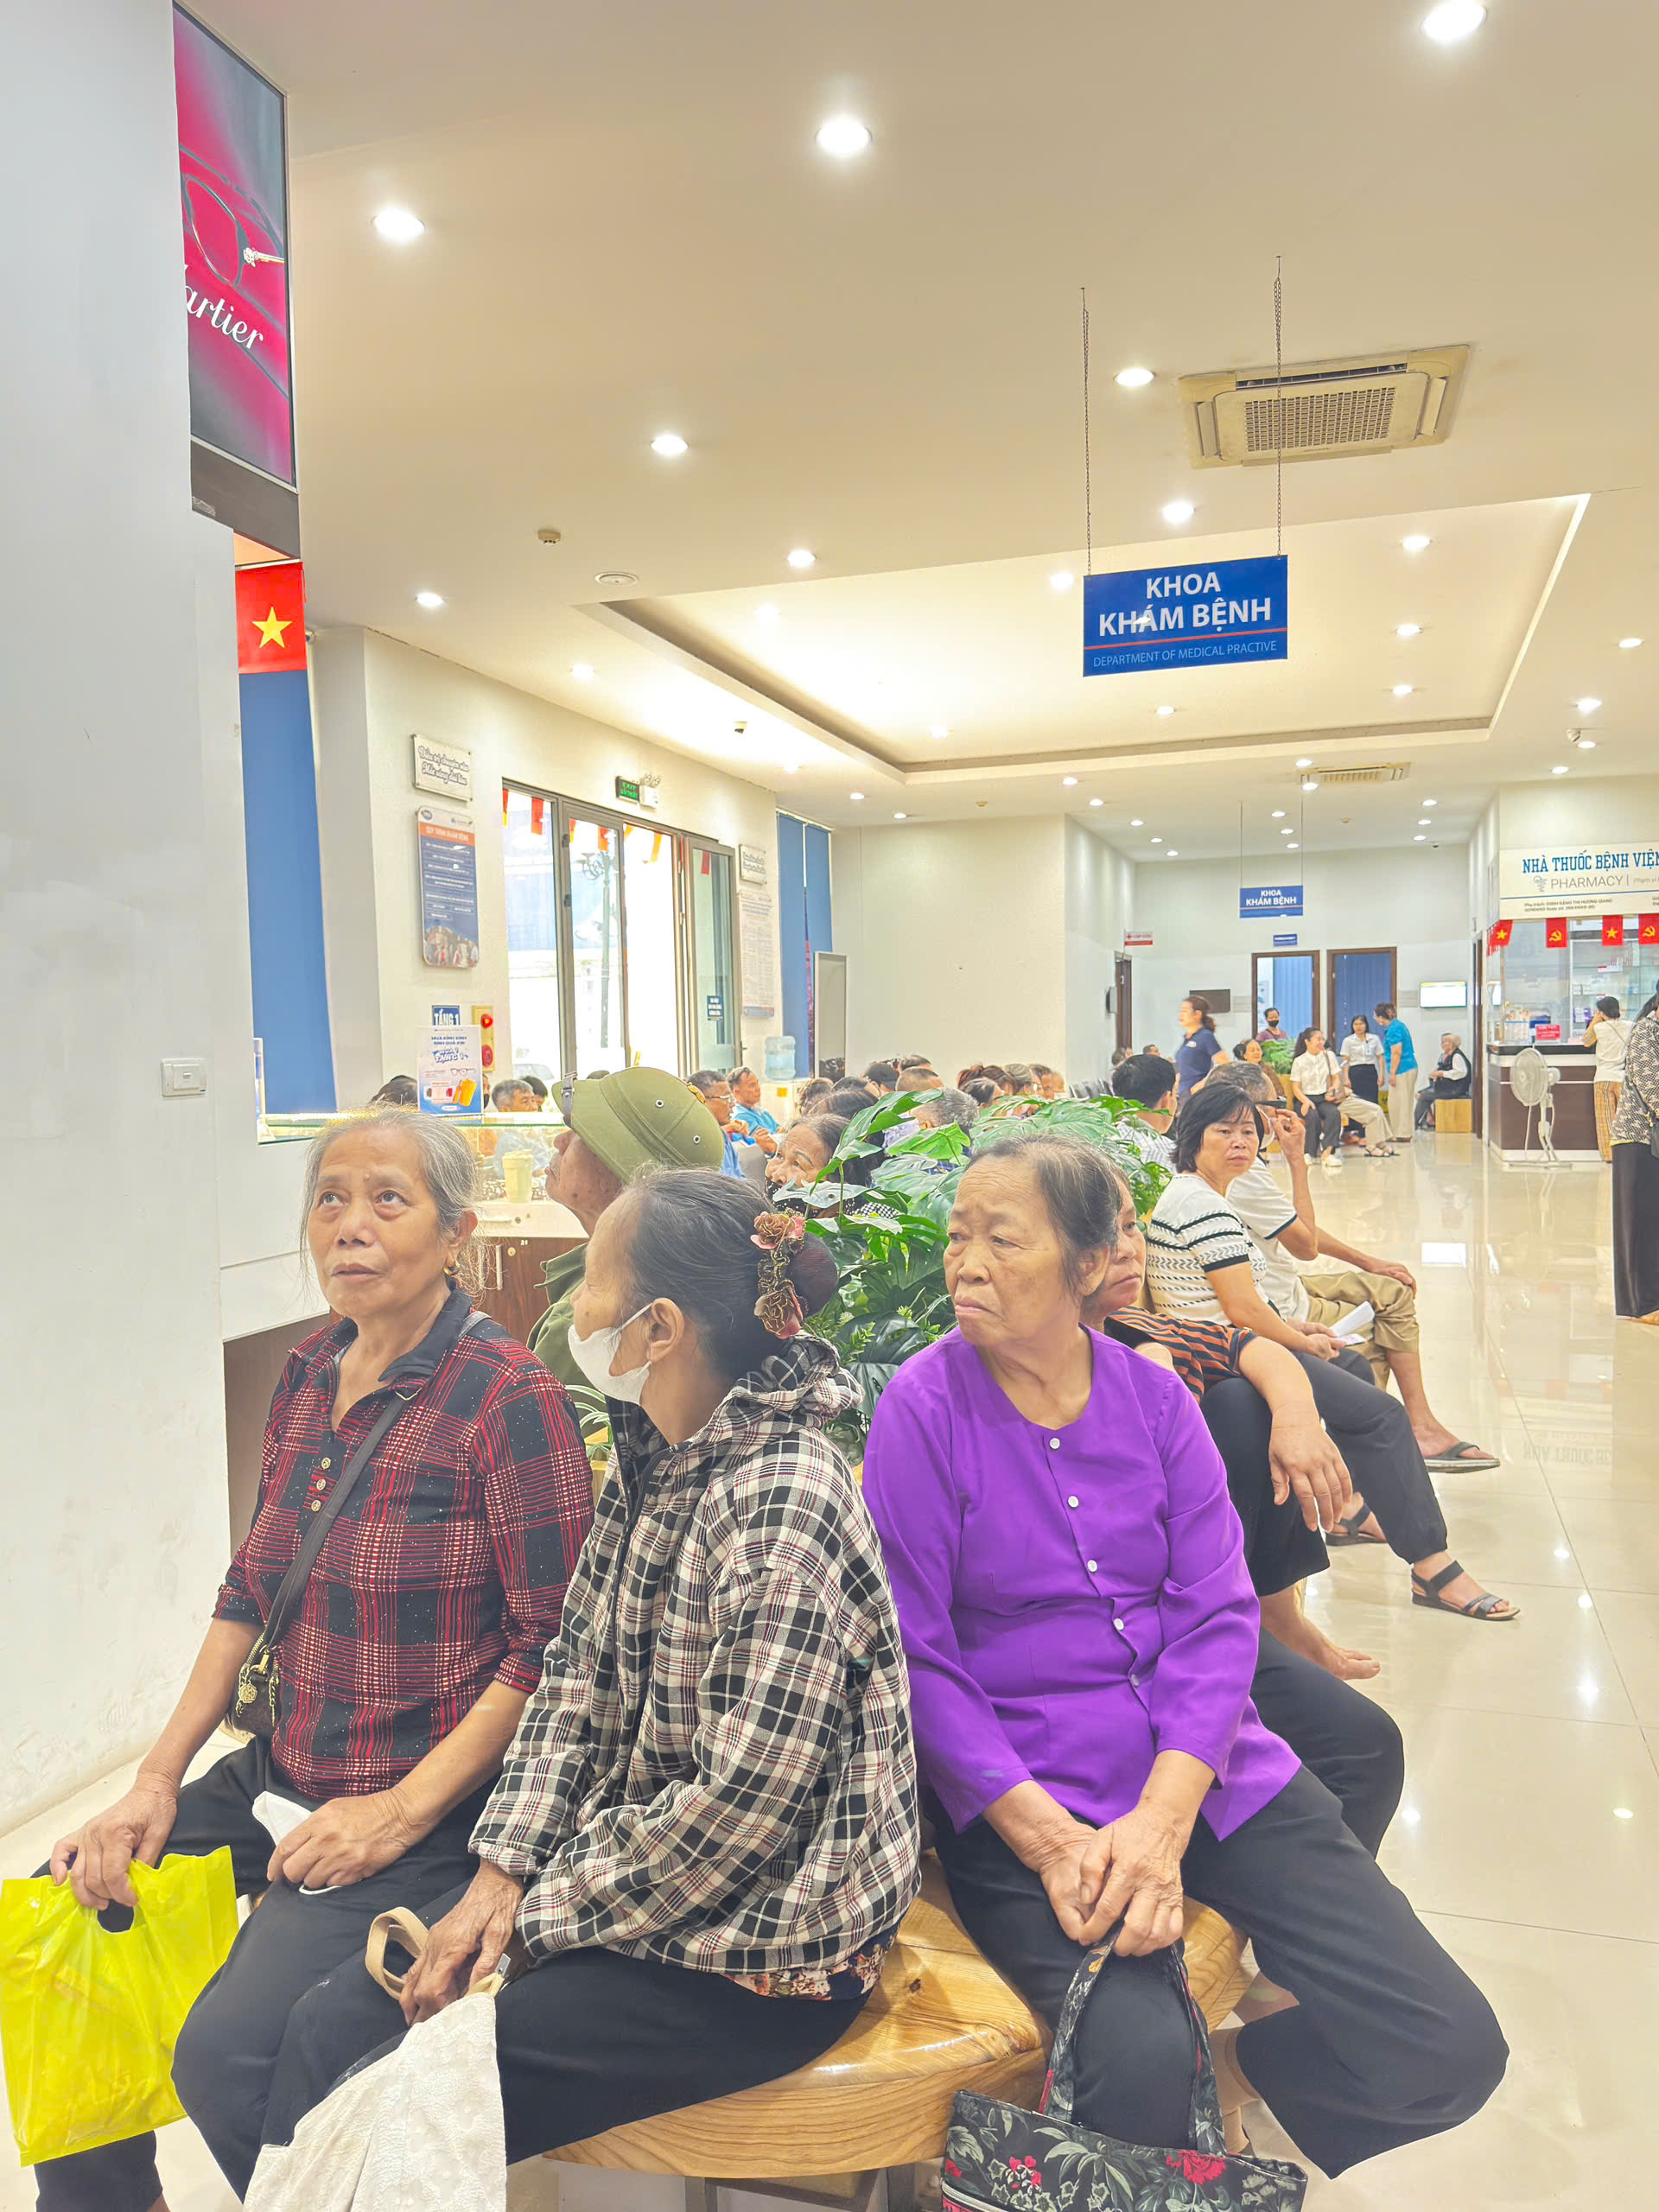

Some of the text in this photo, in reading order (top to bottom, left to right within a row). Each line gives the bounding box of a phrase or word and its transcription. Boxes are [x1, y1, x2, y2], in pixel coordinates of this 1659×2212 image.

[185, 284, 264, 349] artier
[1146, 571, 1221, 599] KHOA
[1099, 597, 1271, 637] KHÁM BỆNH
[1093, 640, 1277, 667] DEPARTMENT OF MEDICAL PRACTIVE
[1522, 855, 1548, 874] NHÀ
[1551, 849, 1592, 872] THUỐC
[1595, 851, 1629, 872] BỆNH
[1550, 874, 1624, 889] PHARMACY
[1245, 895, 1297, 906] KHÁM BỆNH
